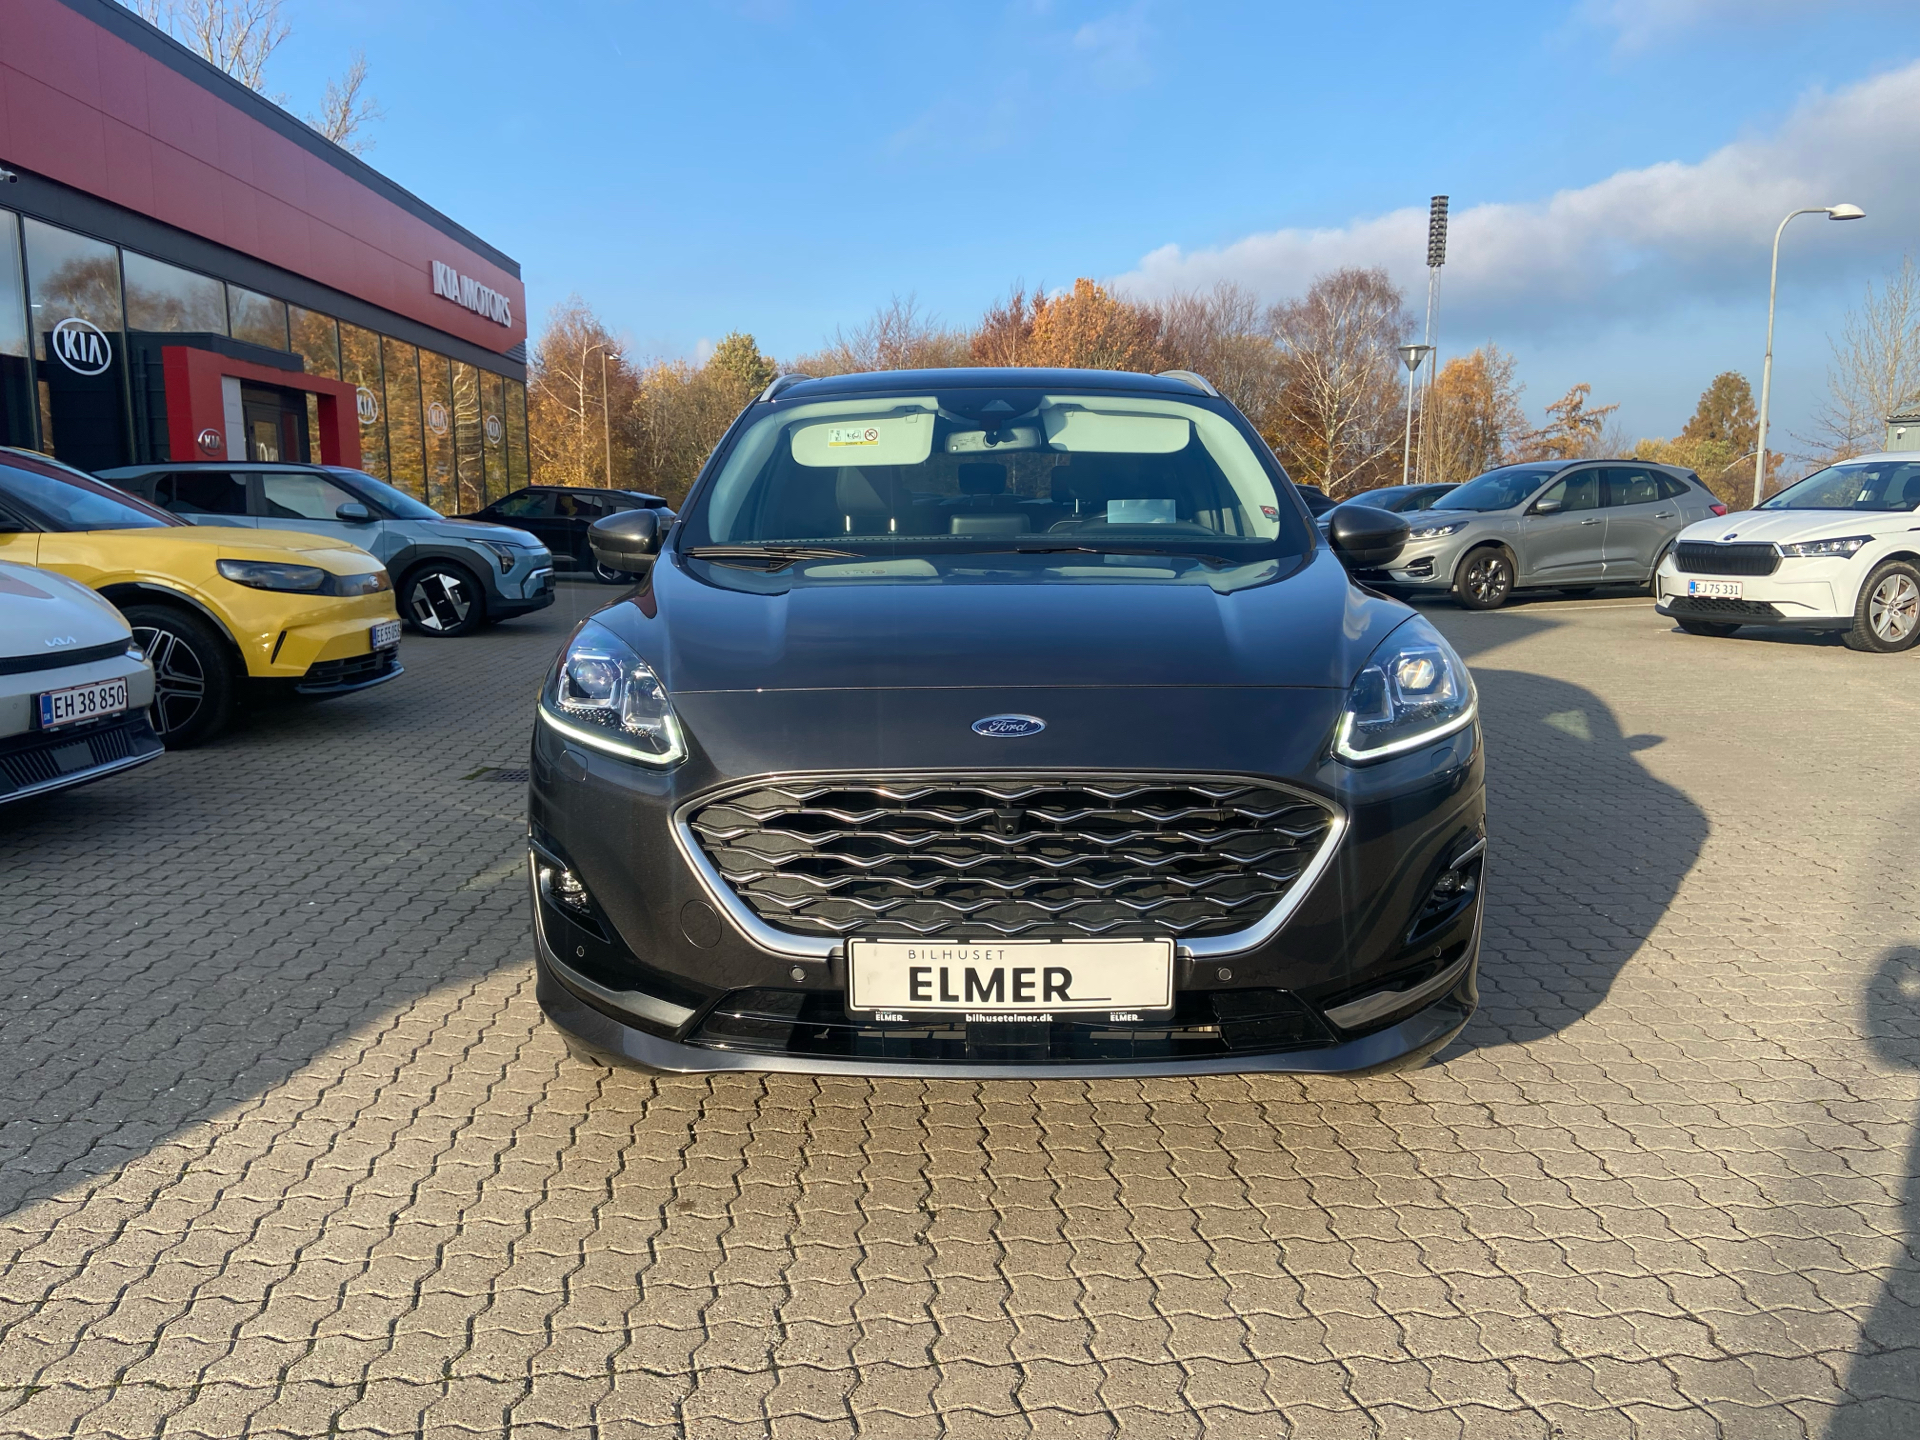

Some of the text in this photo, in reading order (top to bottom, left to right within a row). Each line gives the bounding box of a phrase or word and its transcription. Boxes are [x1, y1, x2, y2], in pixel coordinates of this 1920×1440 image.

[432, 260, 512, 328] KIA MOTORS
[63, 328, 104, 365] KIA
[1695, 583, 1707, 593] EJ
[1709, 584, 1720, 594] 75
[1722, 585, 1739, 595] 331
[54, 695, 75, 719] EH
[78, 690, 97, 714] 38
[99, 685, 125, 709] 850
[988, 720, 1028, 732] Ford
[908, 949, 1006, 961] BILHUSET
[909, 966, 1111, 1002] ELMER
[965, 1013, 1053, 1023] bilhusetelmer.dk
